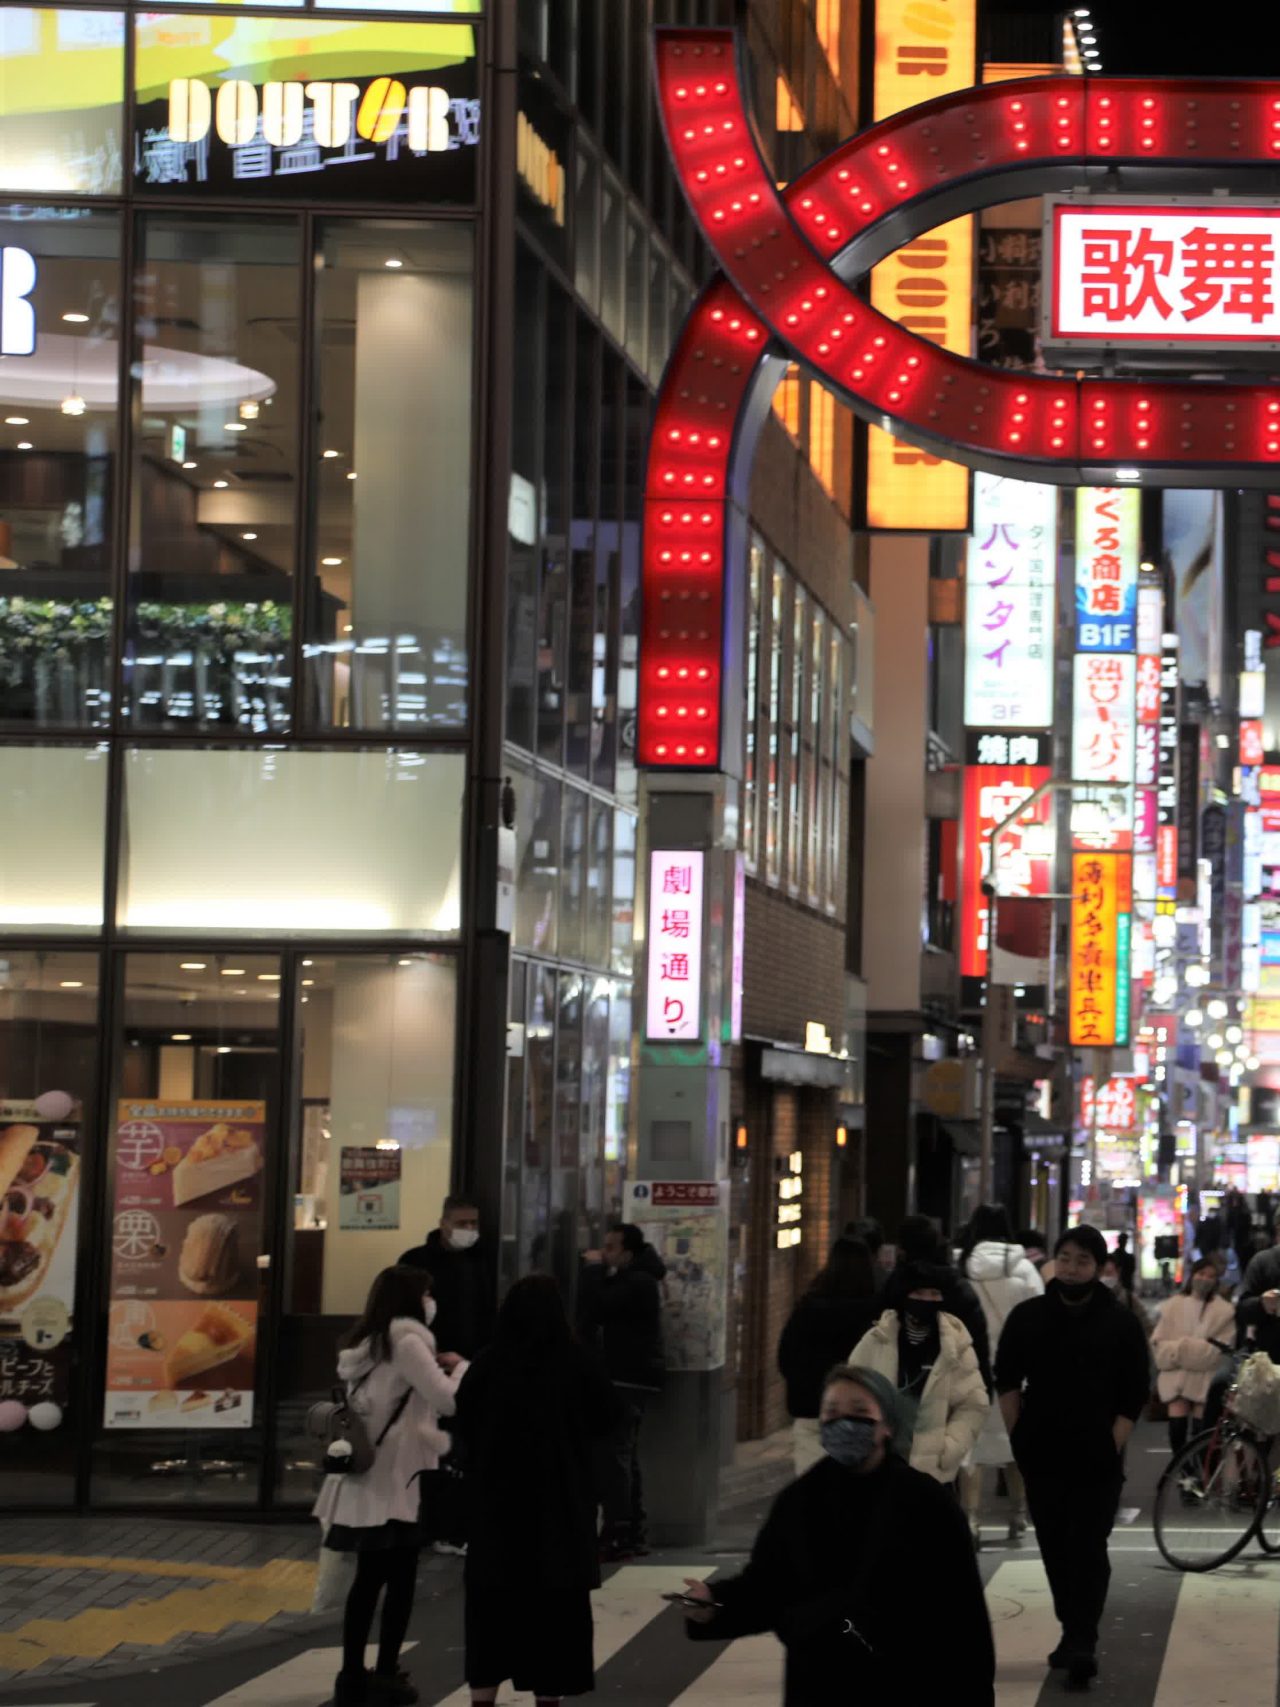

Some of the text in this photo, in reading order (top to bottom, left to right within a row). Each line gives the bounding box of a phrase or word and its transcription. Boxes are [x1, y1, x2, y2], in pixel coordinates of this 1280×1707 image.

[168, 77, 451, 152] DOUTOR
[1091, 487, 1121, 613] くろ商店
[1080, 624, 1131, 647] B1F
[992, 705, 1021, 720] 3F
[661, 866, 692, 1023] 劇場通り
[113, 1216, 156, 1255] 栗
[1, 1357, 55, 1378] ビーフと
[0, 1378, 55, 1397] ルチーズ
